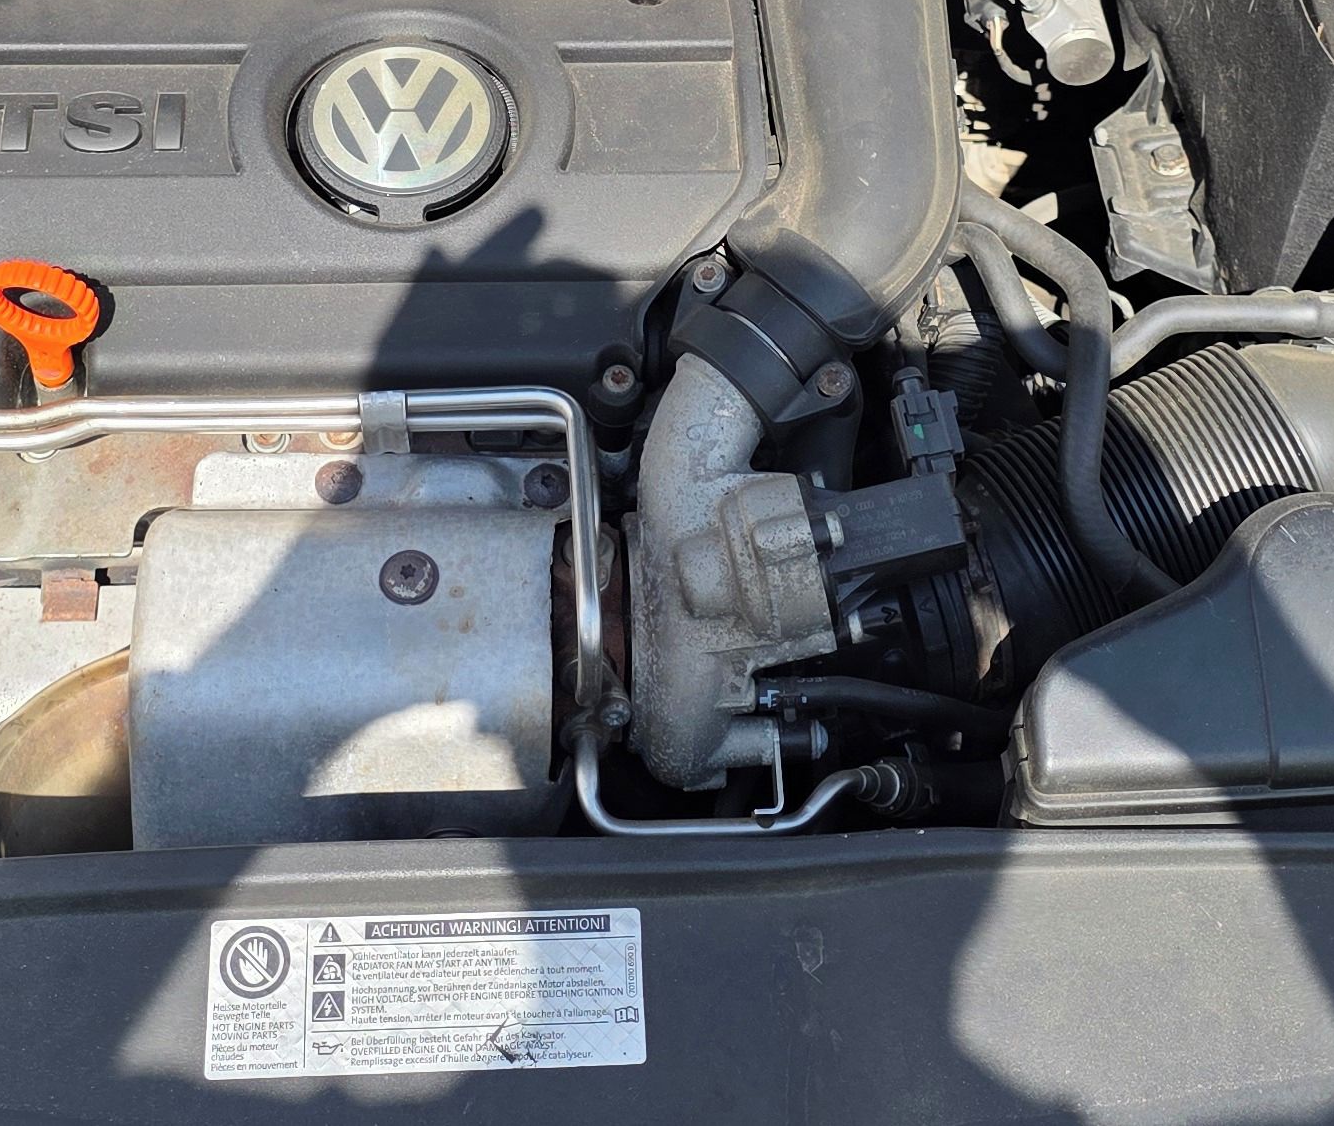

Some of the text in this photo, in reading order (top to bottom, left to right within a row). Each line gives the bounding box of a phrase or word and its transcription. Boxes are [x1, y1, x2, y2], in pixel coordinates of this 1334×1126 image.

[312, 45, 492, 190] VW
[371, 917, 605, 937] ACHTUNG! WARNING! ATTENTION!
[352, 950, 419, 961] Kühlerventilator
[421, 950, 442, 959] kann
[443, 948, 479, 961] jederzeit
[352, 961, 394, 971] RADIATOR
[396, 961, 413, 969] FAN
[415, 960, 434, 969] MAY
[436, 959, 461, 968] START
[462, 959, 473, 967] AT
[475, 958, 493, 967] ANY
[363, 970, 408, 980] ventilateur
[410, 970, 420, 978] de
[422, 969, 460, 978] radiateur
[462, 968, 481, 980] peut
[494, 966, 539, 975] déclencher
[547, 965, 564, 974] tout
[567, 964, 604, 973] moment.
[418, 985, 431, 993] vor
[433, 983, 471, 992] Berühren
[473, 982, 486, 991] der
[488, 980, 538, 991] Zündanlage
[539, 979, 565, 989] Motor
[352, 995, 374, 1004] HIGH
[417, 993, 451, 1003] SWITCH
[452, 993, 469, 1001] OFF
[470, 991, 503, 1000] ENGINE
[504, 990, 536, 999] BEFORE
[538, 988, 586, 998] TOUCHING
[586, 987, 624, 996] IGNITION
[213, 1001, 287, 1011] Heisse Motorteile
[351, 1005, 387, 1014] SYSTEM.
[213, 1010, 270, 1022] Bewegte Teile
[351, 1015, 377, 1024] Haute
[379, 1014, 413, 1023] tension,
[414, 1013, 442, 1022] arrêter
[453, 1013, 484, 1021] moteur
[485, 1011, 509, 1019] avant
[523, 1009, 555, 1018] toucher
[213, 1021, 294, 1031] HOT ENGINE PARTS
[212, 1031, 277, 1040] MOVING PARTS
[351, 1037, 364, 1045] Bei
[367, 1035, 417, 1046] Überfüllung
[419, 1034, 451, 1043] besteht
[453, 1033, 483, 1043] Gefahr
[212, 1044, 235, 1053] Pièces
[250, 1043, 278, 1051] moteur
[351, 1046, 400, 1056] OVERFILLED
[402, 1045, 435, 1054] ENGINE
[437, 1044, 451, 1053] OIL
[455, 1044, 473, 1052] CAN
[211, 1053, 244, 1061] chaudes
[351, 1057, 403, 1067] Remplissage
[405, 1055, 438, 1064] excessif
[441, 1054, 469, 1063] d'huile
[549, 1050, 593, 1060] catalyseur.
[211, 1063, 235, 1072] Pièces
[249, 1060, 298, 1070] mouvement
